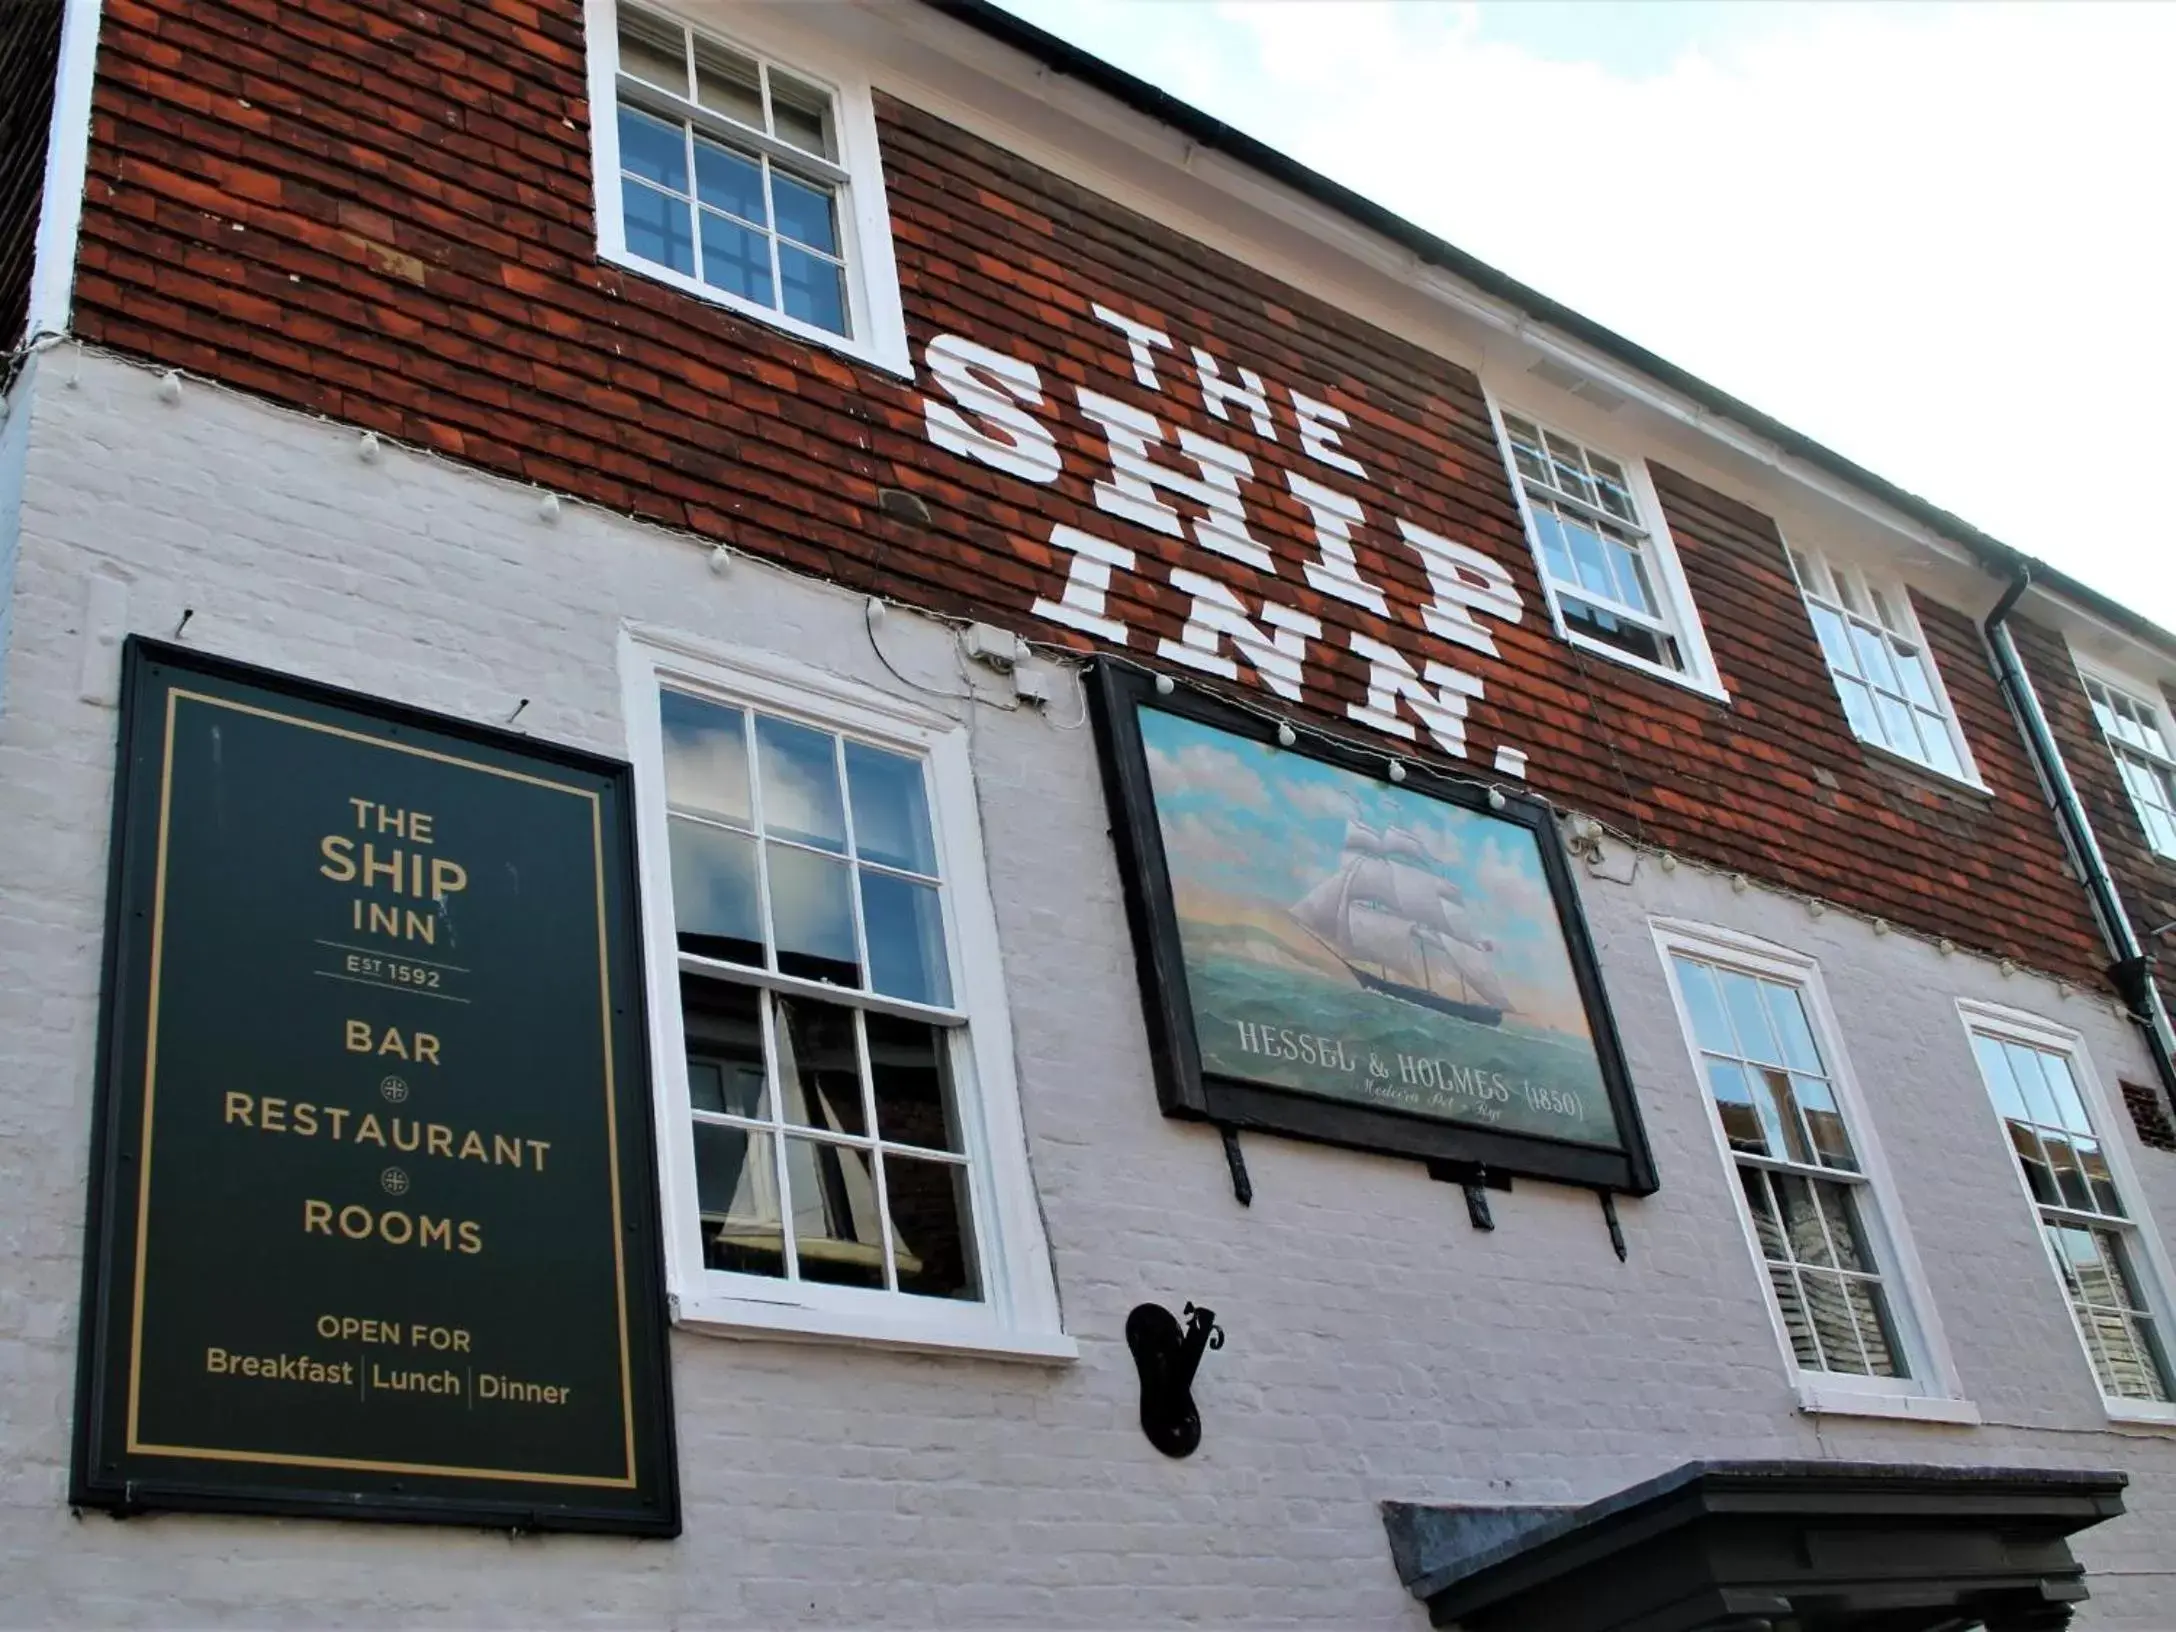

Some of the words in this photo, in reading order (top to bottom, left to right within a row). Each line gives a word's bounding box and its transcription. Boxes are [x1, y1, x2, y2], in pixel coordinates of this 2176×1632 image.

[1092, 302, 1369, 480] THE
[922, 332, 1525, 659] SHIP
[349, 797, 434, 843] THE
[320, 836, 467, 901] SHIP
[353, 899, 435, 944] INN
[388, 963, 441, 988] 1592
[345, 1019, 441, 1065] BAR
[1237, 1020, 1356, 1072] HESSEL
[1368, 1047, 1390, 1079] &
[1398, 1053, 1509, 1102] HOLMES
[1523, 1080, 1583, 1121] (1850)
[225, 1091, 551, 1171] RESTAURANT
[304, 1200, 483, 1254] ROOMS
[317, 1315, 400, 1345] OPEN
[411, 1325, 471, 1352] FOR
[206, 1347, 353, 1386] Breakfast
[373, 1364, 460, 1395] Lunch
[479, 1375, 570, 1405] Dinner
